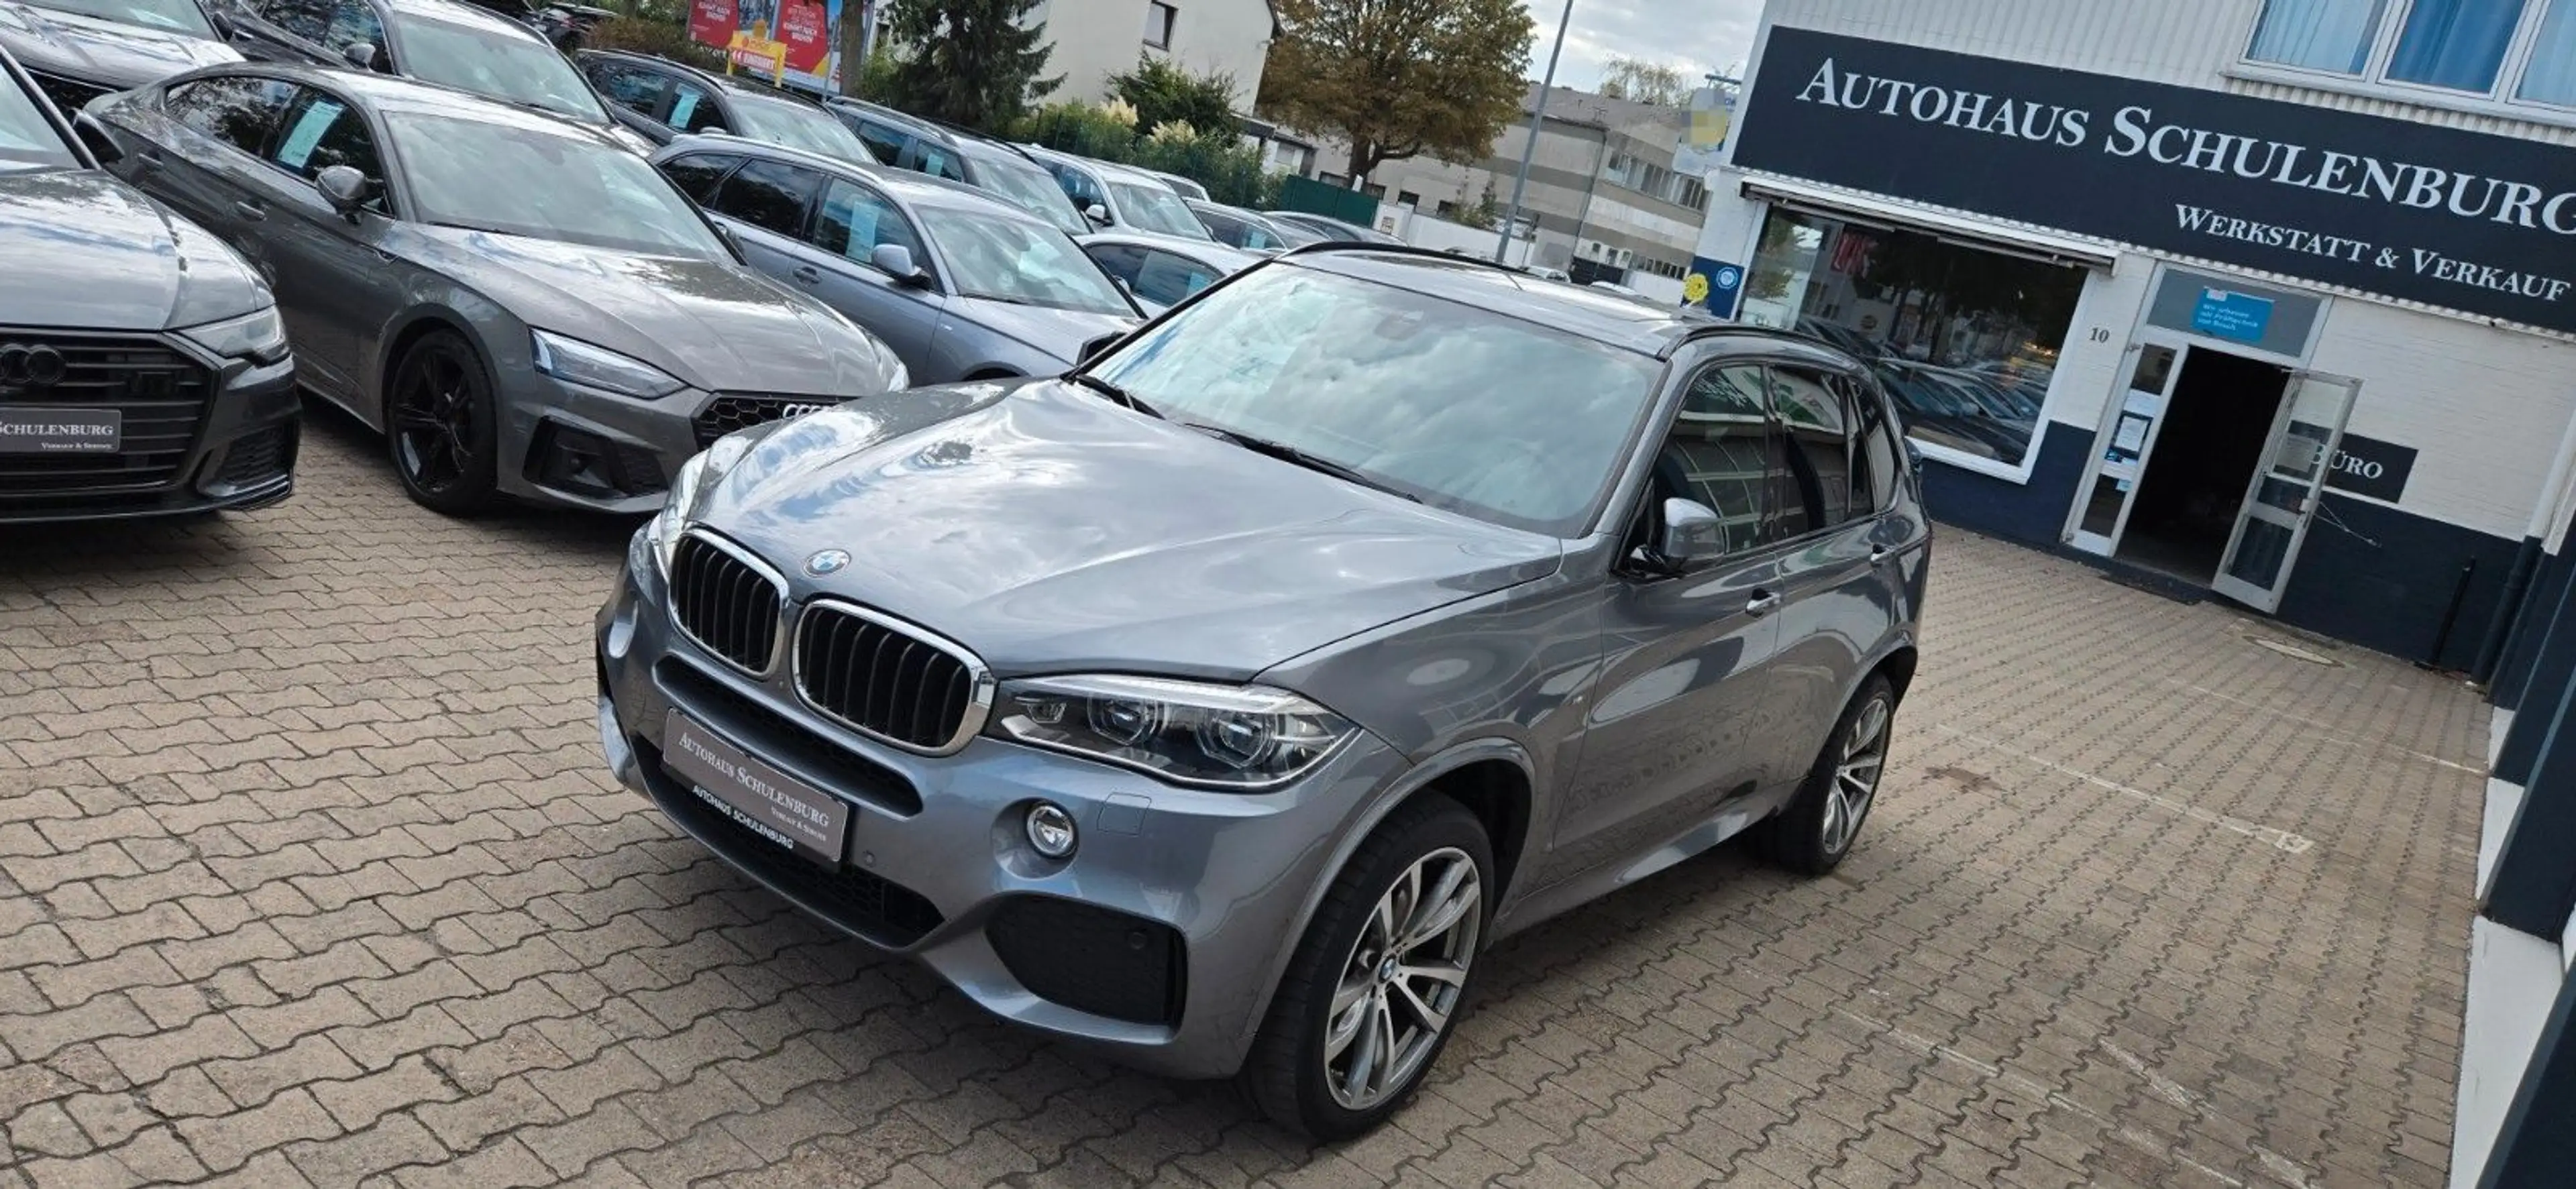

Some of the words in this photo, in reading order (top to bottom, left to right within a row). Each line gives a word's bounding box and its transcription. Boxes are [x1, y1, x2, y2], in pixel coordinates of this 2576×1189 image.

[1796, 57, 2090, 148] AUTOHAUS
[2104, 105, 2576, 235] SCHULENBURG
[2175, 204, 2371, 263] WERKSTATT
[2375, 247, 2402, 269] &
[2411, 247, 2572, 302] VERKAUF
[2089, 327, 2110, 343] 10
[679, 732, 735, 779] AUTOHAUS
[737, 766, 829, 828] SCHULENBURG
[692, 785, 733, 816] AUTOHAUS
[733, 809, 794, 850] SCHULENBURG
